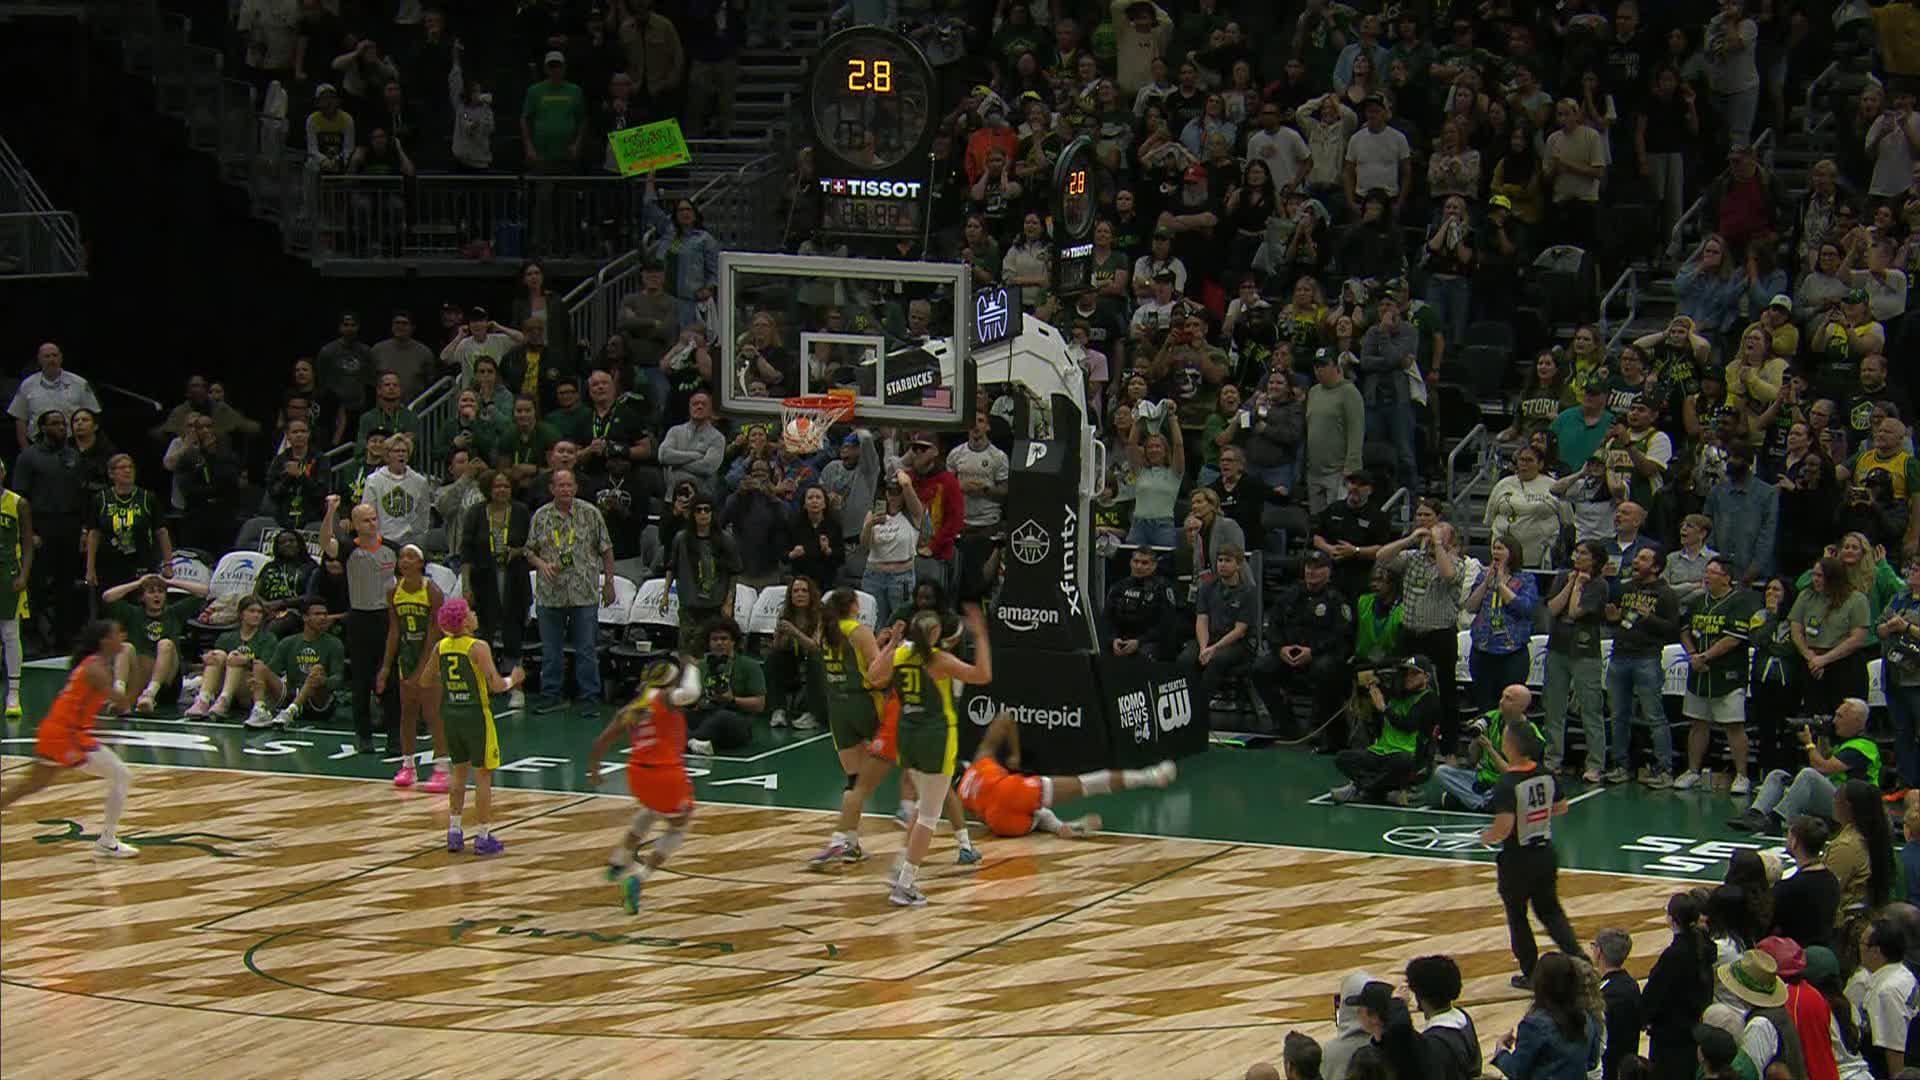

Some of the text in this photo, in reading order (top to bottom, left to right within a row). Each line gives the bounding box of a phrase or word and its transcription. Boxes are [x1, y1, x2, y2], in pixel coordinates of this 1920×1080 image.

[848, 59, 891, 92] 2.8
[847, 180, 921, 198] TISSOT
[1071, 243, 1094, 258] TISSOT
[885, 371, 935, 396] STARBUCKS
[1521, 397, 1559, 417] STORM
[107, 503, 142, 517] SOM
[1060, 503, 1081, 616] xfinity
[219, 572, 255, 580] SYMETR
[997, 605, 1060, 624] amazon
[447, 655, 461, 680] 2
[902, 667, 922, 694] 31
[1118, 690, 1146, 714] KOMO
[1158, 688, 1192, 732] CW
[1000, 701, 1082, 730] Intrepid
[1120, 707, 1149, 729] NEWS
[1143, 722, 1151, 740] 4
